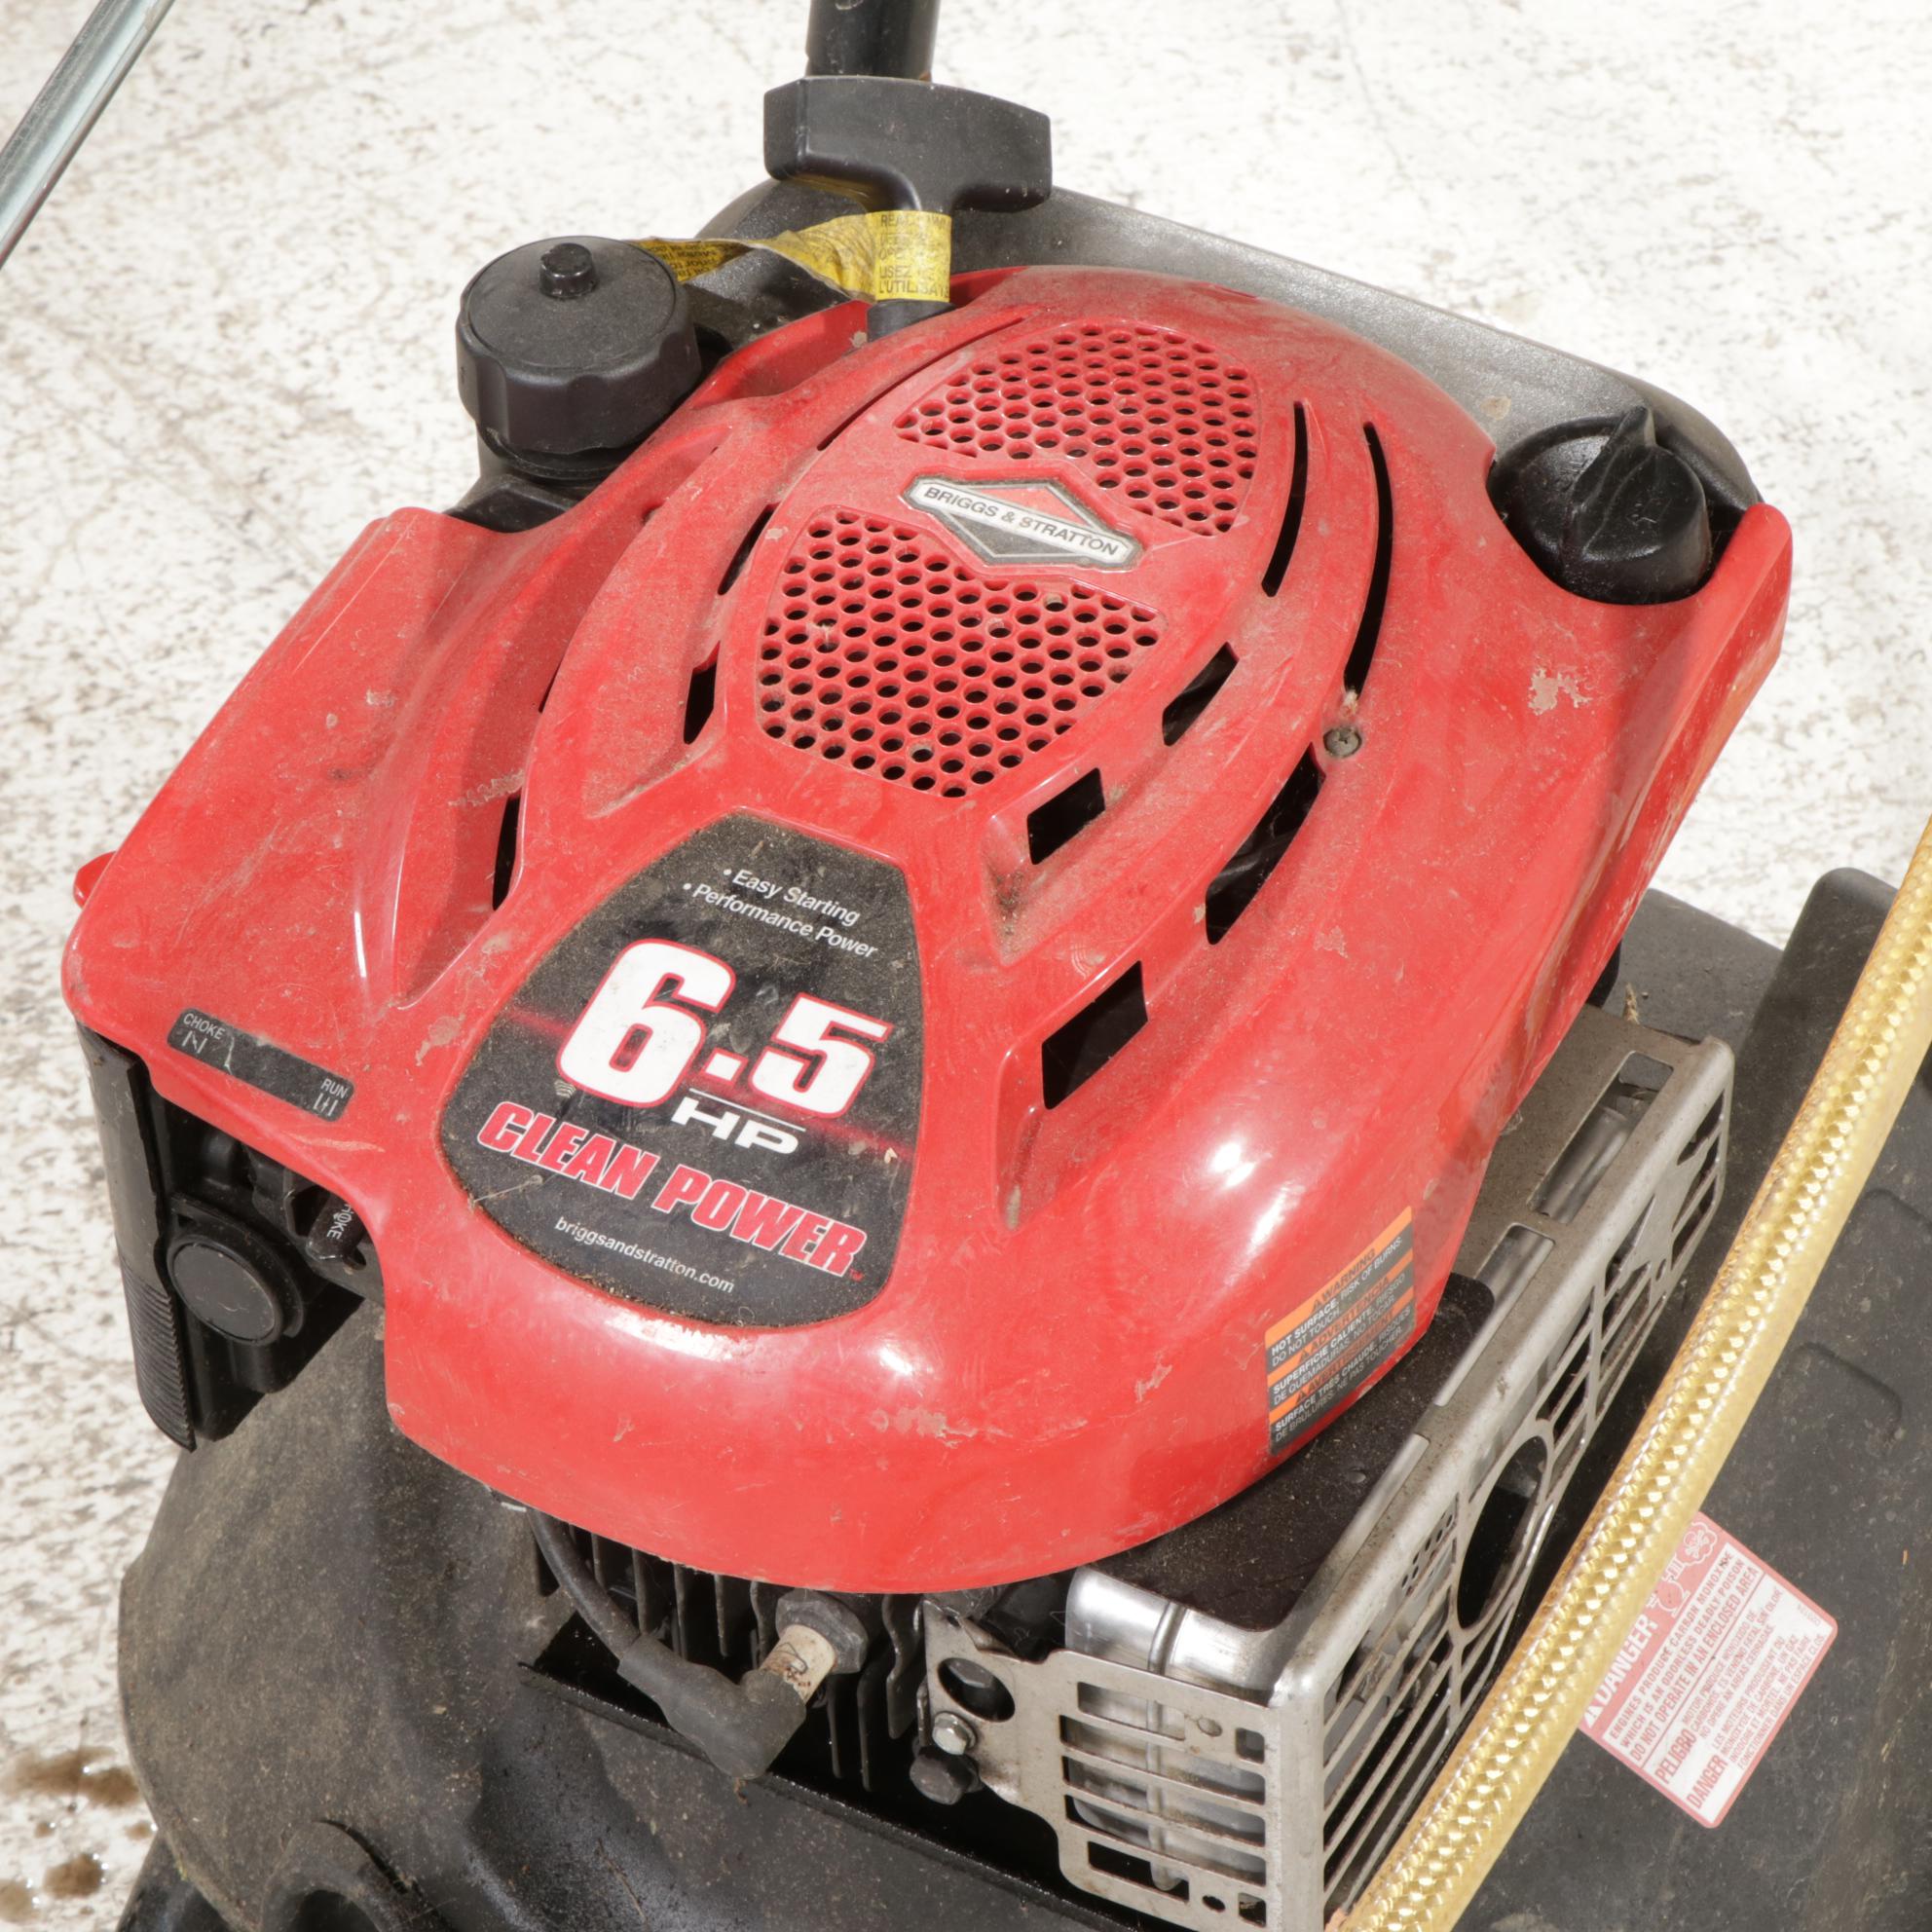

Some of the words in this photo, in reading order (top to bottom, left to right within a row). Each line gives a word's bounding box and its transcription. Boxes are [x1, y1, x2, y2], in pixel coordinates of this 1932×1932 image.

[925, 487, 998, 517] BRIGGS
[1001, 511, 1015, 523] &
[1020, 517, 1118, 555] STRATTON
[692, 883, 813, 936] Performance
[815, 926, 877, 957] Power
[732, 870, 782, 899] Easy
[784, 887, 861, 926] Starting
[183, 1014, 225, 1040] CHOKE
[556, 938, 893, 1119] 6.5
[320, 1078, 348, 1098] RUN
[670, 1096, 799, 1155] HP
[326, 1204, 354, 1240] HOKE
[476, 1101, 659, 1200] CLEAN
[651, 1165, 868, 1278] POWER
[555, 1217, 734, 1292] briggsandstratton.com
[1320, 1246, 1375, 1304] WARNING
[1272, 1330, 1291, 1359] HOT
[1340, 1275, 1359, 1301] RISK
[1361, 1263, 1371, 1282] OF
[1272, 1346, 1286, 1369] DO
[1288, 1331, 1306, 1357] NOT
[1274, 1387, 1286, 1406] DE
[1354, 1319, 1365, 1340] NO
[1274, 1340, 1327, 1397] SUPERFICIE
[1276, 1427, 1286, 1443] DE
[1337, 1374, 1347, 1392] NE
[1350, 1359, 1363, 1380] PAS
[1276, 1392, 1315, 1433] SURFACE
[1589, 1612, 1658, 1708] DANGER
[1609, 1693, 1642, 1740] ENGINES
[1637, 1645, 1673, 1695] PRODUCE
[1668, 1604, 1700, 1648] CARBON
[1695, 1550, 1733, 1605] MONOXIDE
[1619, 1713, 1646, 1749] WHICH
[1642, 1700, 1654, 1715] IS
[1650, 1685, 1664, 1702] AN
[1659, 1633, 1697, 1687] ODORLESS
[1692, 1595, 1722, 1636] DEADLY
[1717, 1557, 1745, 1597] POISON
[1628, 1741, 1647, 1762] DO
[1639, 1719, 1661, 1746] NOT
[1653, 1672, 1690, 1724] OPERATE
[1683, 1660, 1698, 1677] IN
[1691, 1644, 1709, 1664] AN
[1701, 1592, 1741, 1649] ENCLOSED
[1733, 1564, 1759, 1597] AREA
[1681, 1694, 1703, 1726] MOTOR
[1685, 1752, 1728, 1809] DANGER
